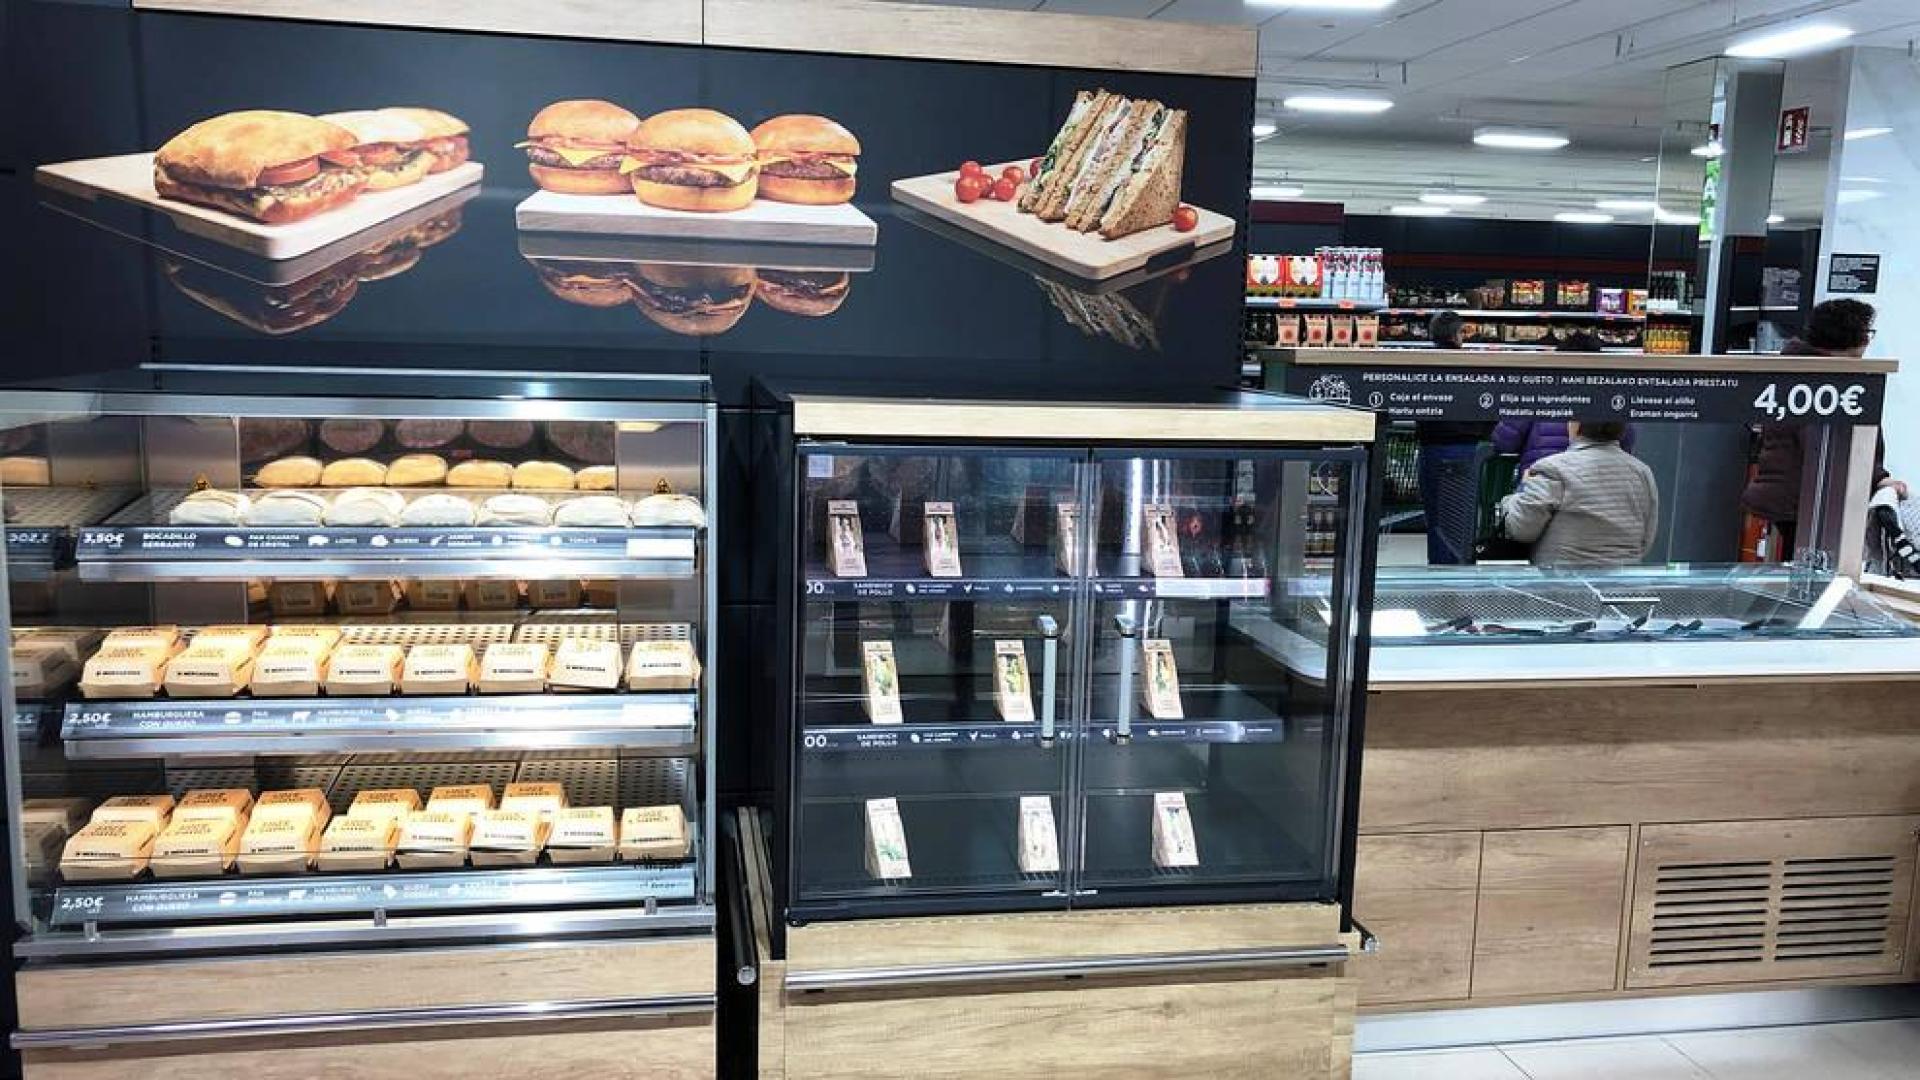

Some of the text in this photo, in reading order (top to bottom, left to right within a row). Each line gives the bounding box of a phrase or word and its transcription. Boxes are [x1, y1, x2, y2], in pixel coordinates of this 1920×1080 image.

[1362, 373, 1429, 383] PERSONALICE
[1430, 373, 1444, 383] LA
[1446, 374, 1496, 383] ENSALADA
[1507, 375, 1521, 384] SU
[1522, 376, 1554, 385] GUSTO
[1586, 376, 1636, 385] BEZALAKO
[1637, 377, 1690, 387] ENTSALADA
[1692, 379, 1739, 388] PRESTATU
[1389, 393, 1454, 402] Coja el envase
[1500, 393, 1520, 403] Elija
[1537, 395, 1591, 404] ingredientes
[1753, 383, 1866, 421] 4,00€
[142, 532, 198, 541] BOCADILLO
[69, 711, 112, 724] 2,50€
[61, 896, 104, 911] 2,50€
